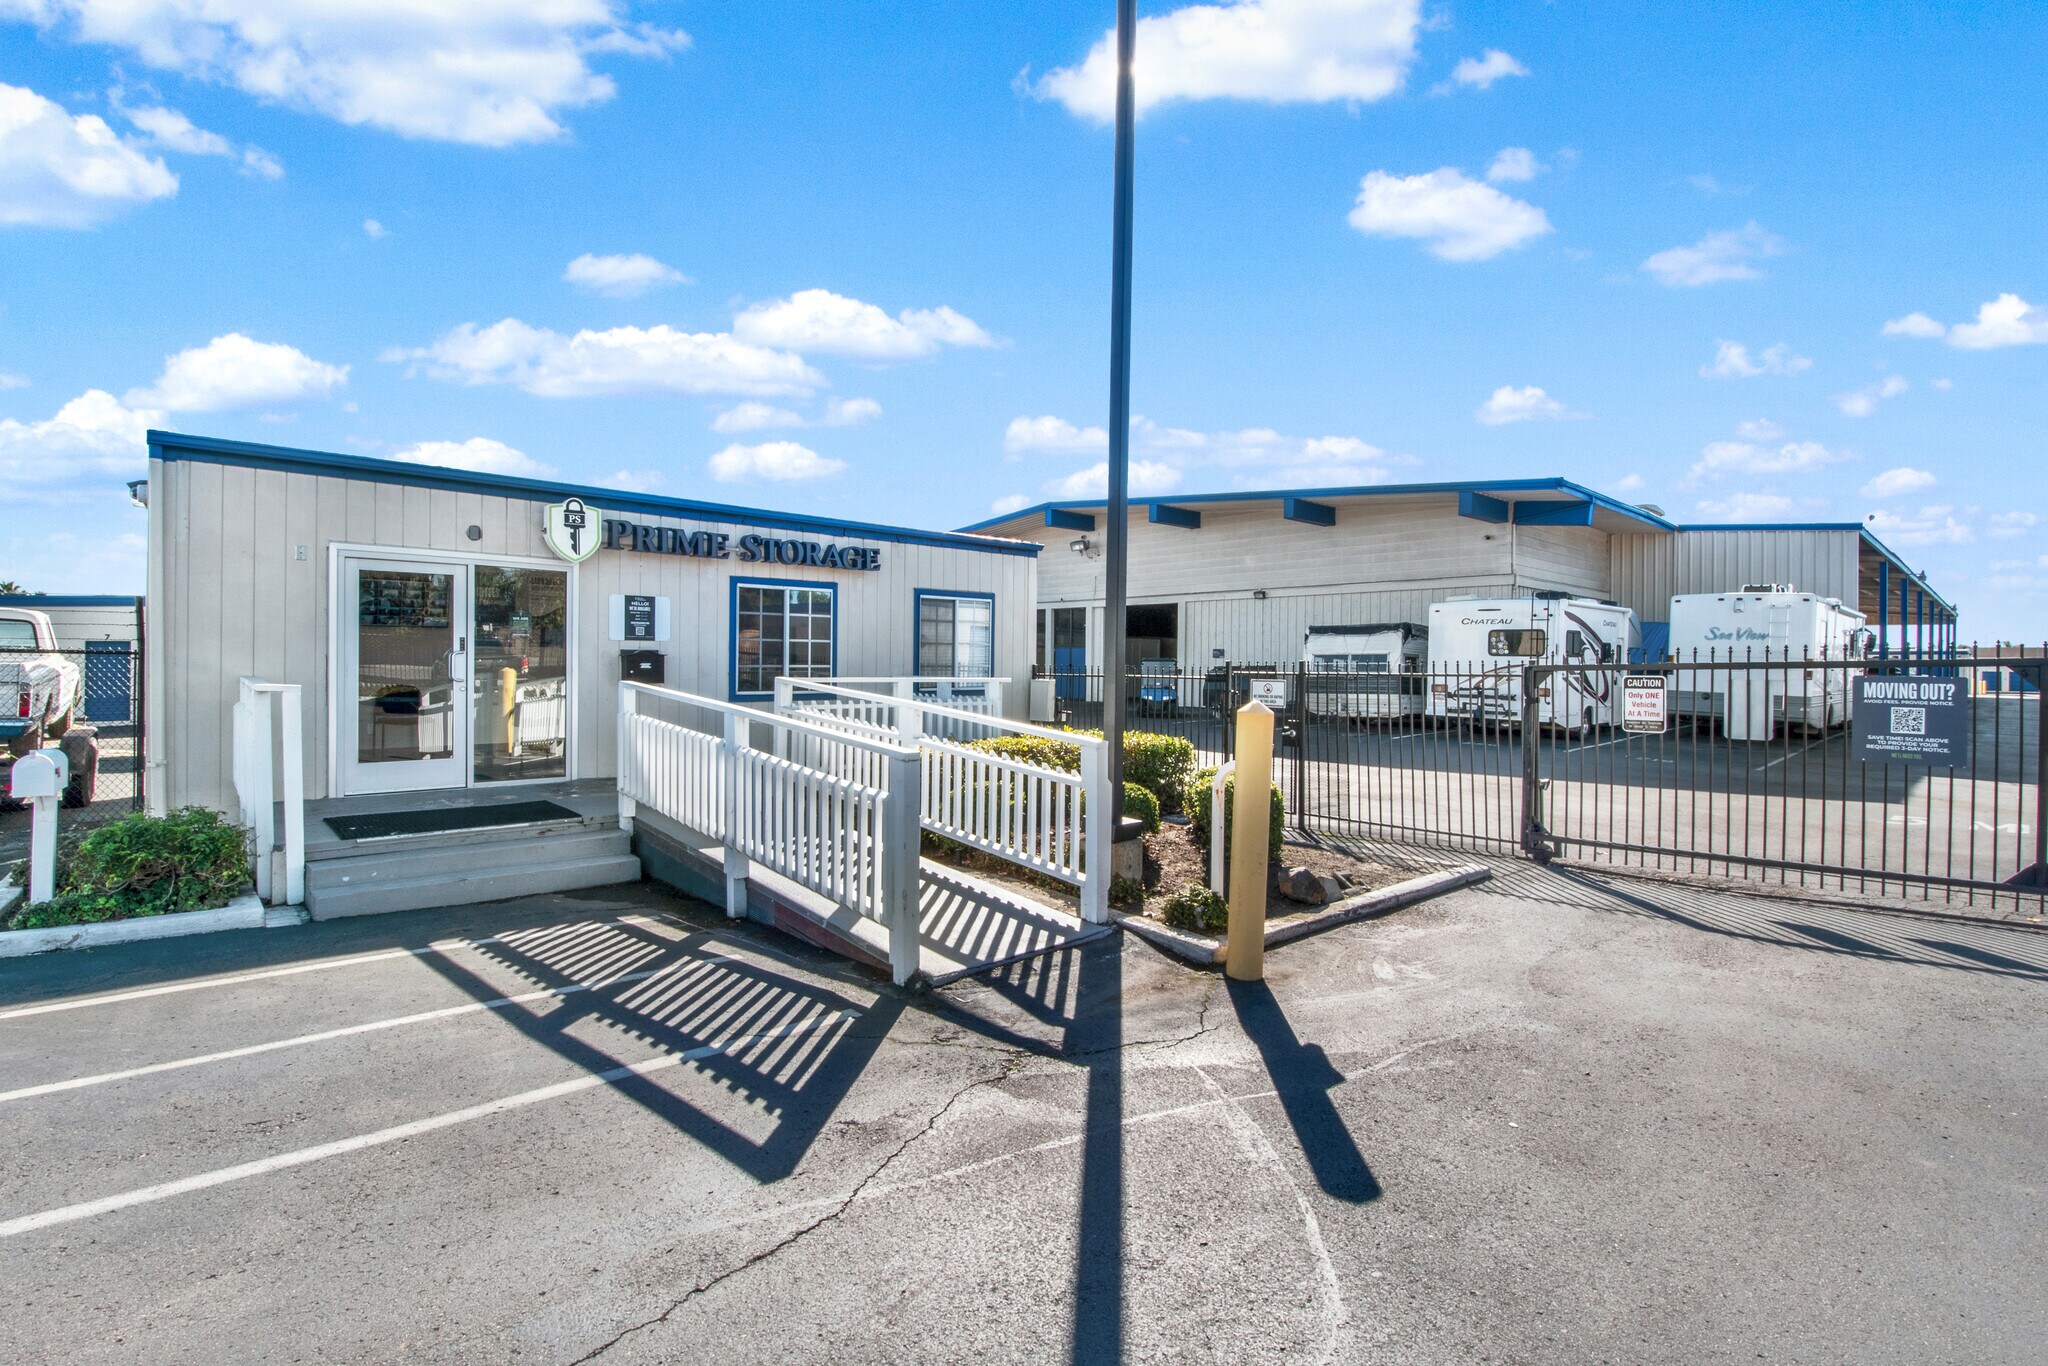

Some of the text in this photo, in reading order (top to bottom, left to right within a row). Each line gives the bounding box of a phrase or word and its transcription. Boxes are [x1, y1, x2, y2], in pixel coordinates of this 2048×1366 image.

[569, 514, 581, 523] PS
[603, 518, 881, 572] PRIME STORAGE
[1461, 617, 1513, 625] CHATEAU
[1627, 679, 1661, 687] CAUTION
[1863, 682, 1955, 700] MOVING OUT?
